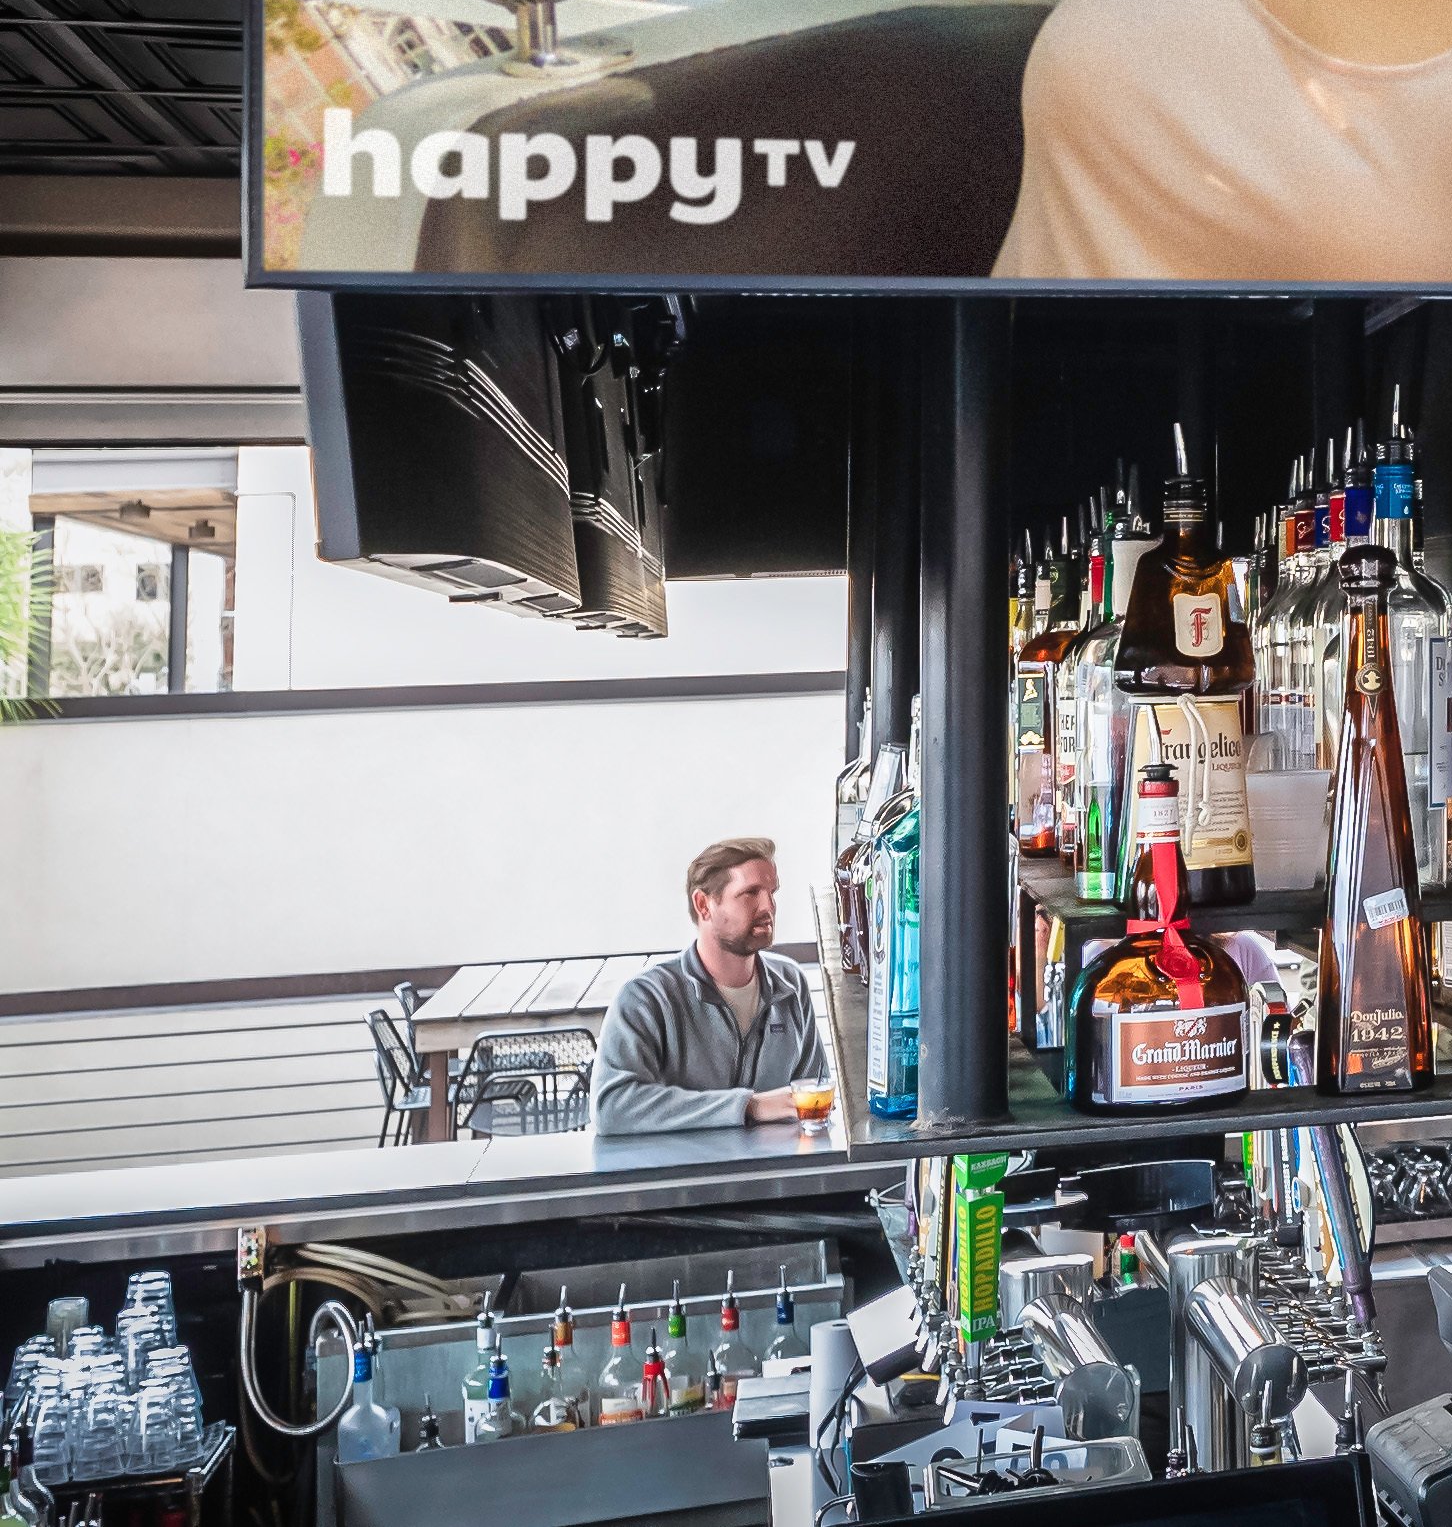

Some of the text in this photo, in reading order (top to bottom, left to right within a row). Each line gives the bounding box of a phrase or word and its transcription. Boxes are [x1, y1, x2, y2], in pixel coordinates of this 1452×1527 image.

[1351, 1025, 1404, 1043] 1942
[973, 1205, 997, 1313] HOPADILLO
[972, 1315, 996, 1333] IPA
